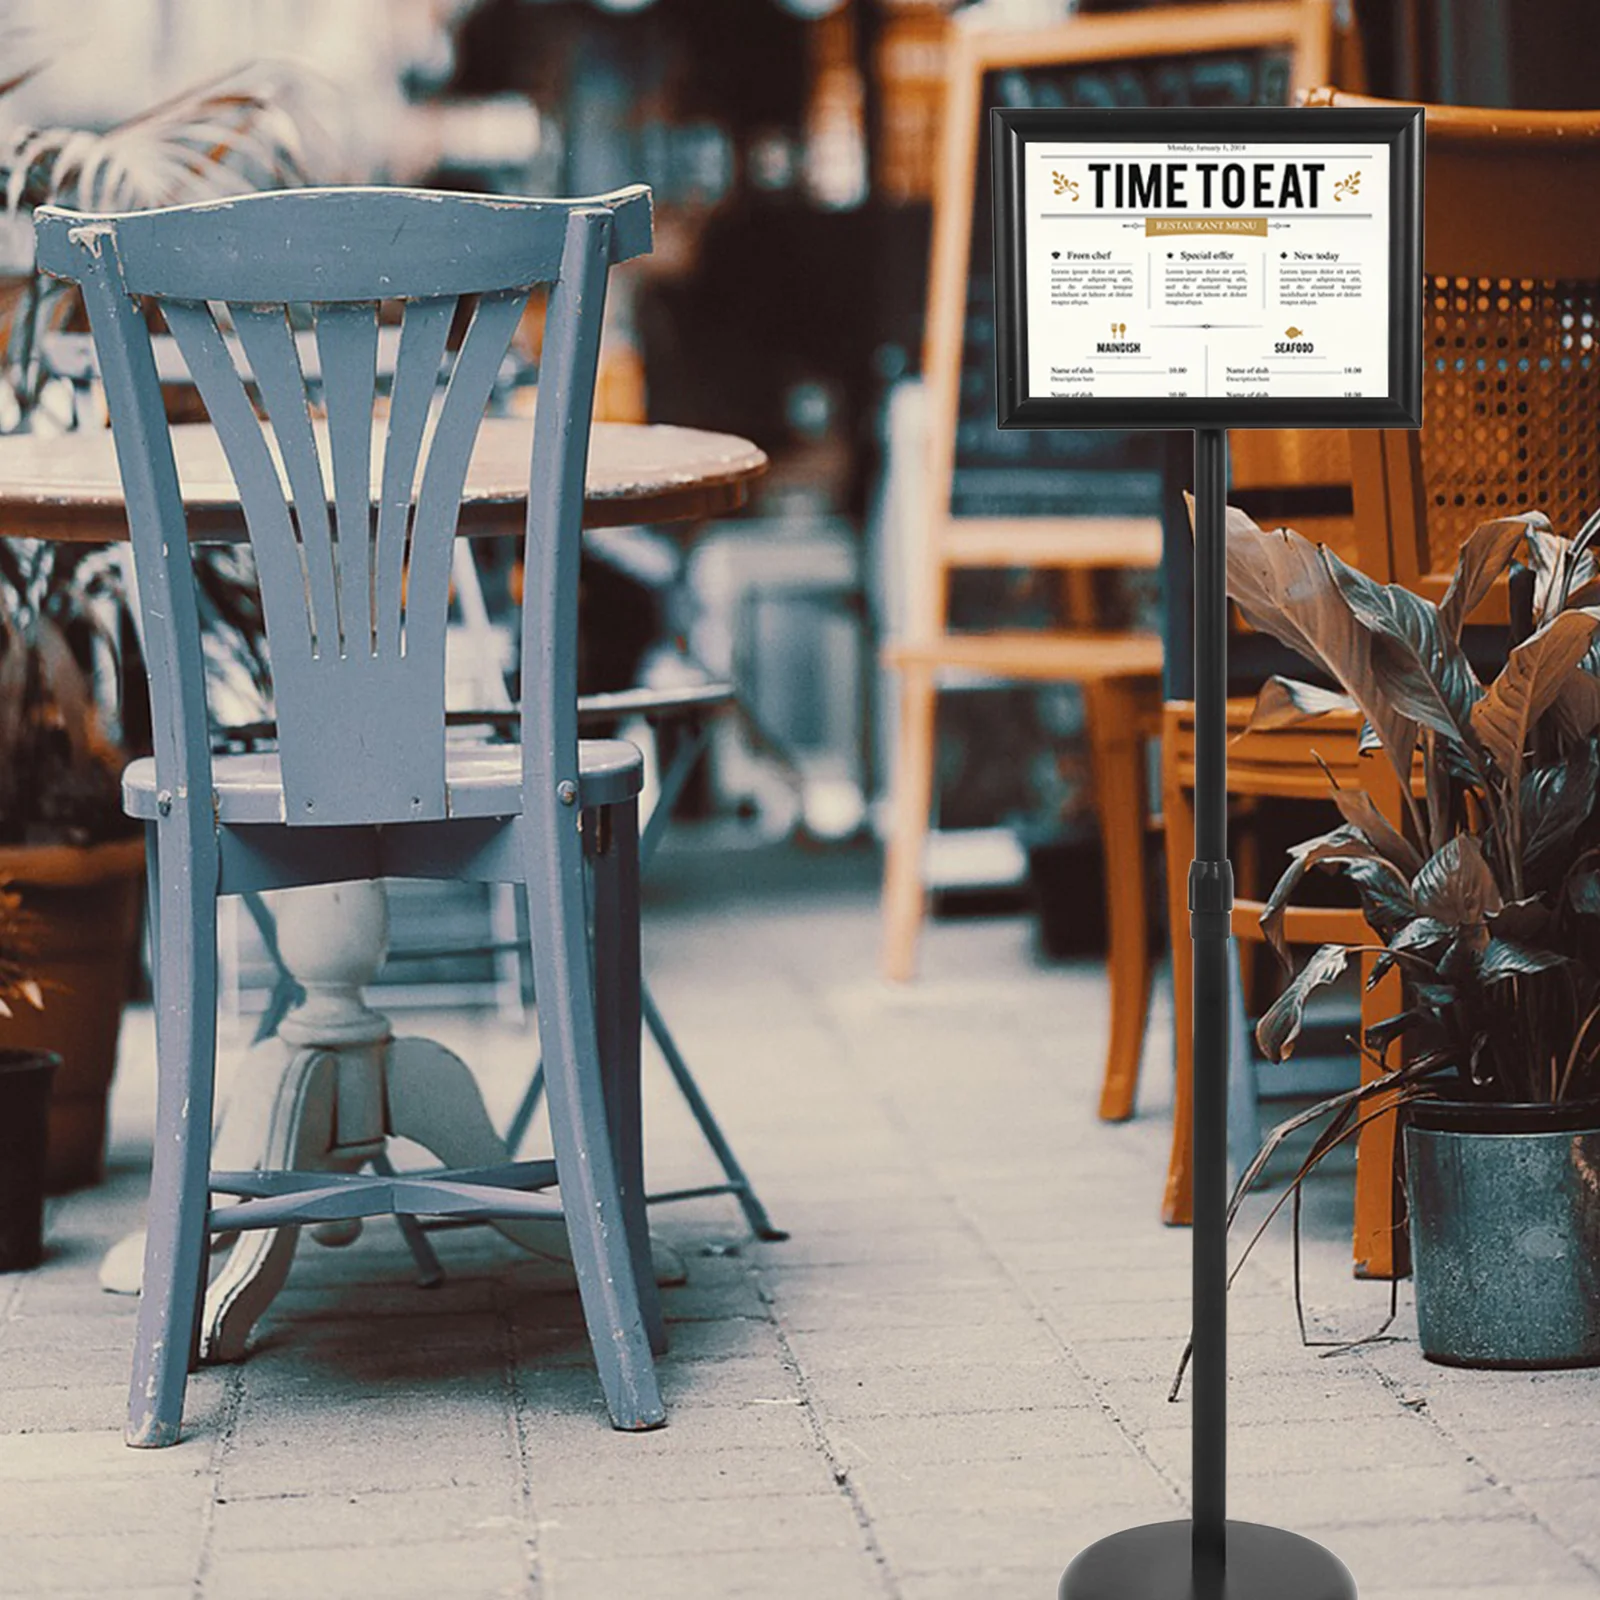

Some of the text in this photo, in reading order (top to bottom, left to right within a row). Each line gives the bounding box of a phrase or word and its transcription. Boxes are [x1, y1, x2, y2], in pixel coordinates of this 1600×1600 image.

[1088, 163, 1325, 209] TIME TO EAT
[1156, 221, 1257, 232] RESTAURANT MENU
[1067, 251, 1113, 260] From chef
[1180, 251, 1235, 262] Special offer
[1294, 251, 1341, 262] New today
[1097, 342, 1142, 353] MAINDISH
[1274, 342, 1315, 353] SEAFOOD
[1051, 366, 1071, 374] Name
[1072, 366, 1080, 374] of
[1080, 366, 1094, 374] dish
[1226, 366, 1245, 374] Name
[1247, 366, 1255, 374] of
[1255, 366, 1270, 374] dish
